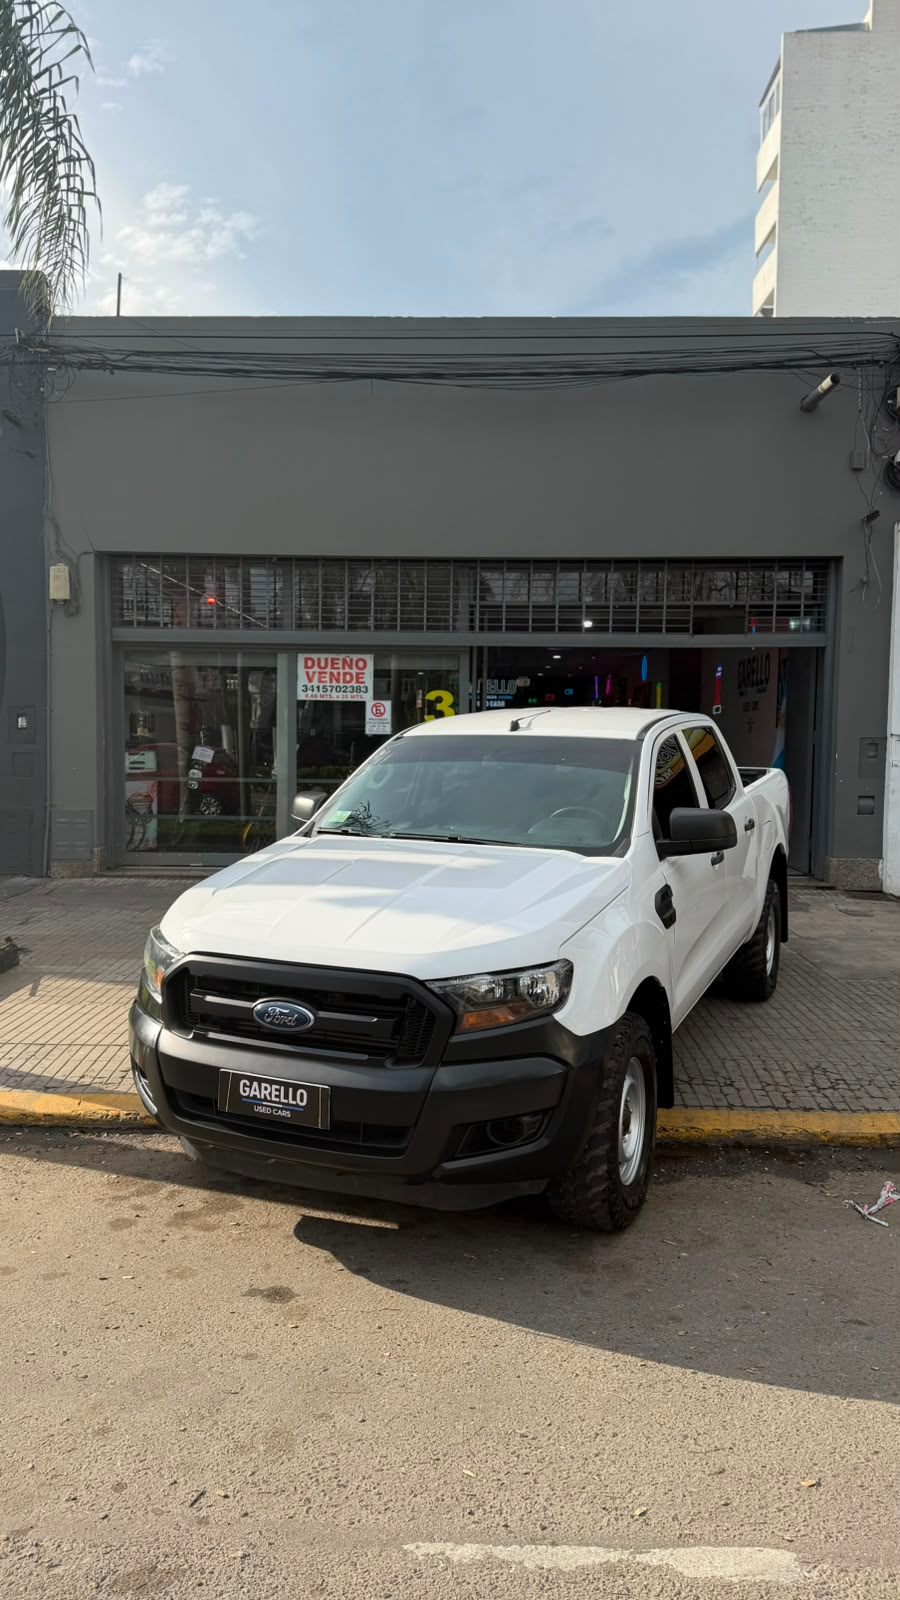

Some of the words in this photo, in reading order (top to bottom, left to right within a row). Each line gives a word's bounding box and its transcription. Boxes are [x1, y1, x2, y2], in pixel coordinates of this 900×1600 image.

[304, 656, 367, 671] DUEÑO
[305, 671, 365, 684] VENDE
[301, 684, 369, 694] 3415702383
[424, 690, 455, 721] 3
[263, 1006, 298, 1026] Ford
[240, 1079, 308, 1107] GARELLO
[254, 1105, 271, 1114] USED
[272, 1108, 291, 1118] CARS
